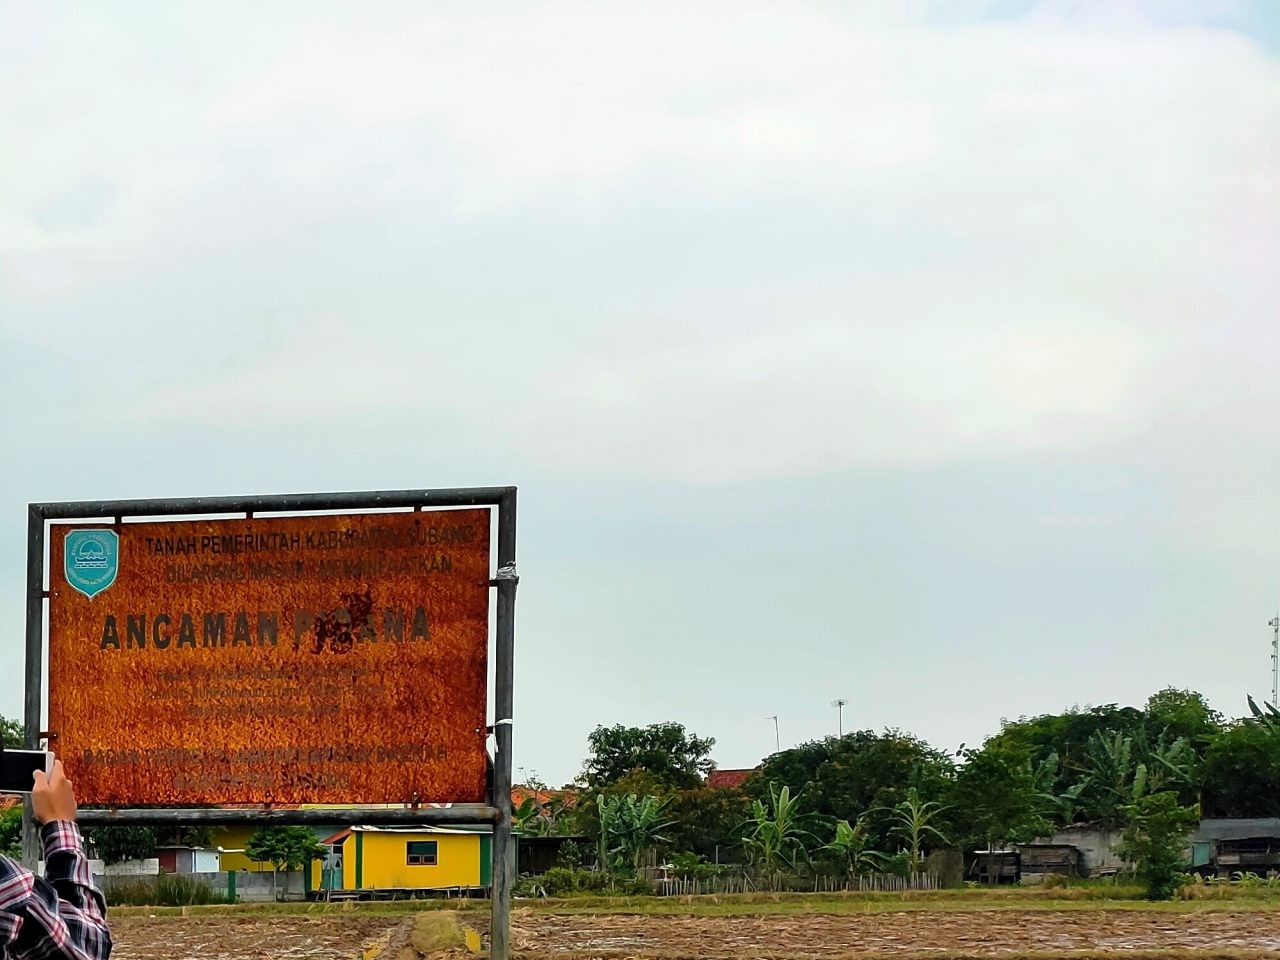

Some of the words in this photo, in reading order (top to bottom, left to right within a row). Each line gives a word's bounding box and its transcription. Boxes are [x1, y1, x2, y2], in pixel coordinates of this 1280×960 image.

[146, 536, 196, 556] TANAH
[200, 532, 300, 555] PEMERINTAH
[100, 609, 278, 650] ANCAMAN
